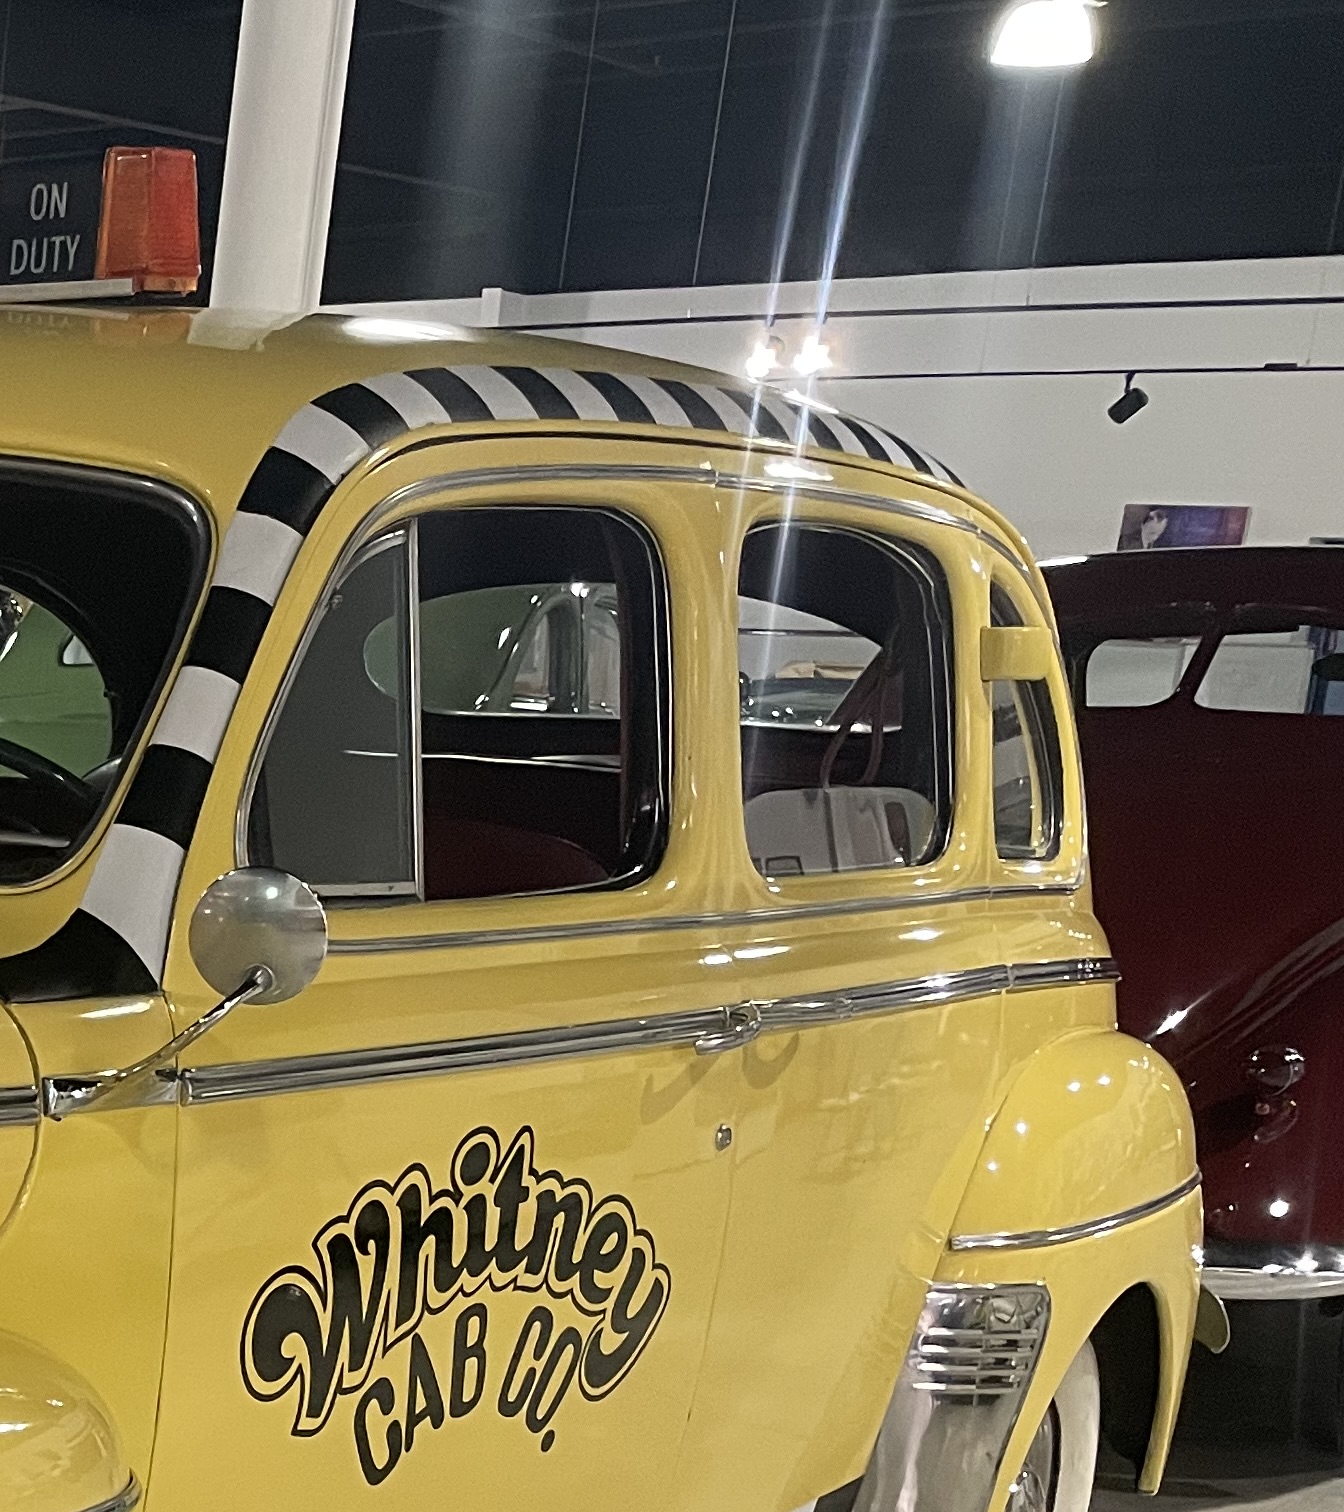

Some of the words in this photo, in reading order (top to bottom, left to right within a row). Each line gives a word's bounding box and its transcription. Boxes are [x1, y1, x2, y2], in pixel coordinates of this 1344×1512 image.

[10, 234, 81, 277] DUTY
[29, 182, 69, 221] ON
[240, 1125, 671, 1437] Whitney
[353, 1303, 488, 1486] CAB
[497, 1305, 582, 1453] CO.
